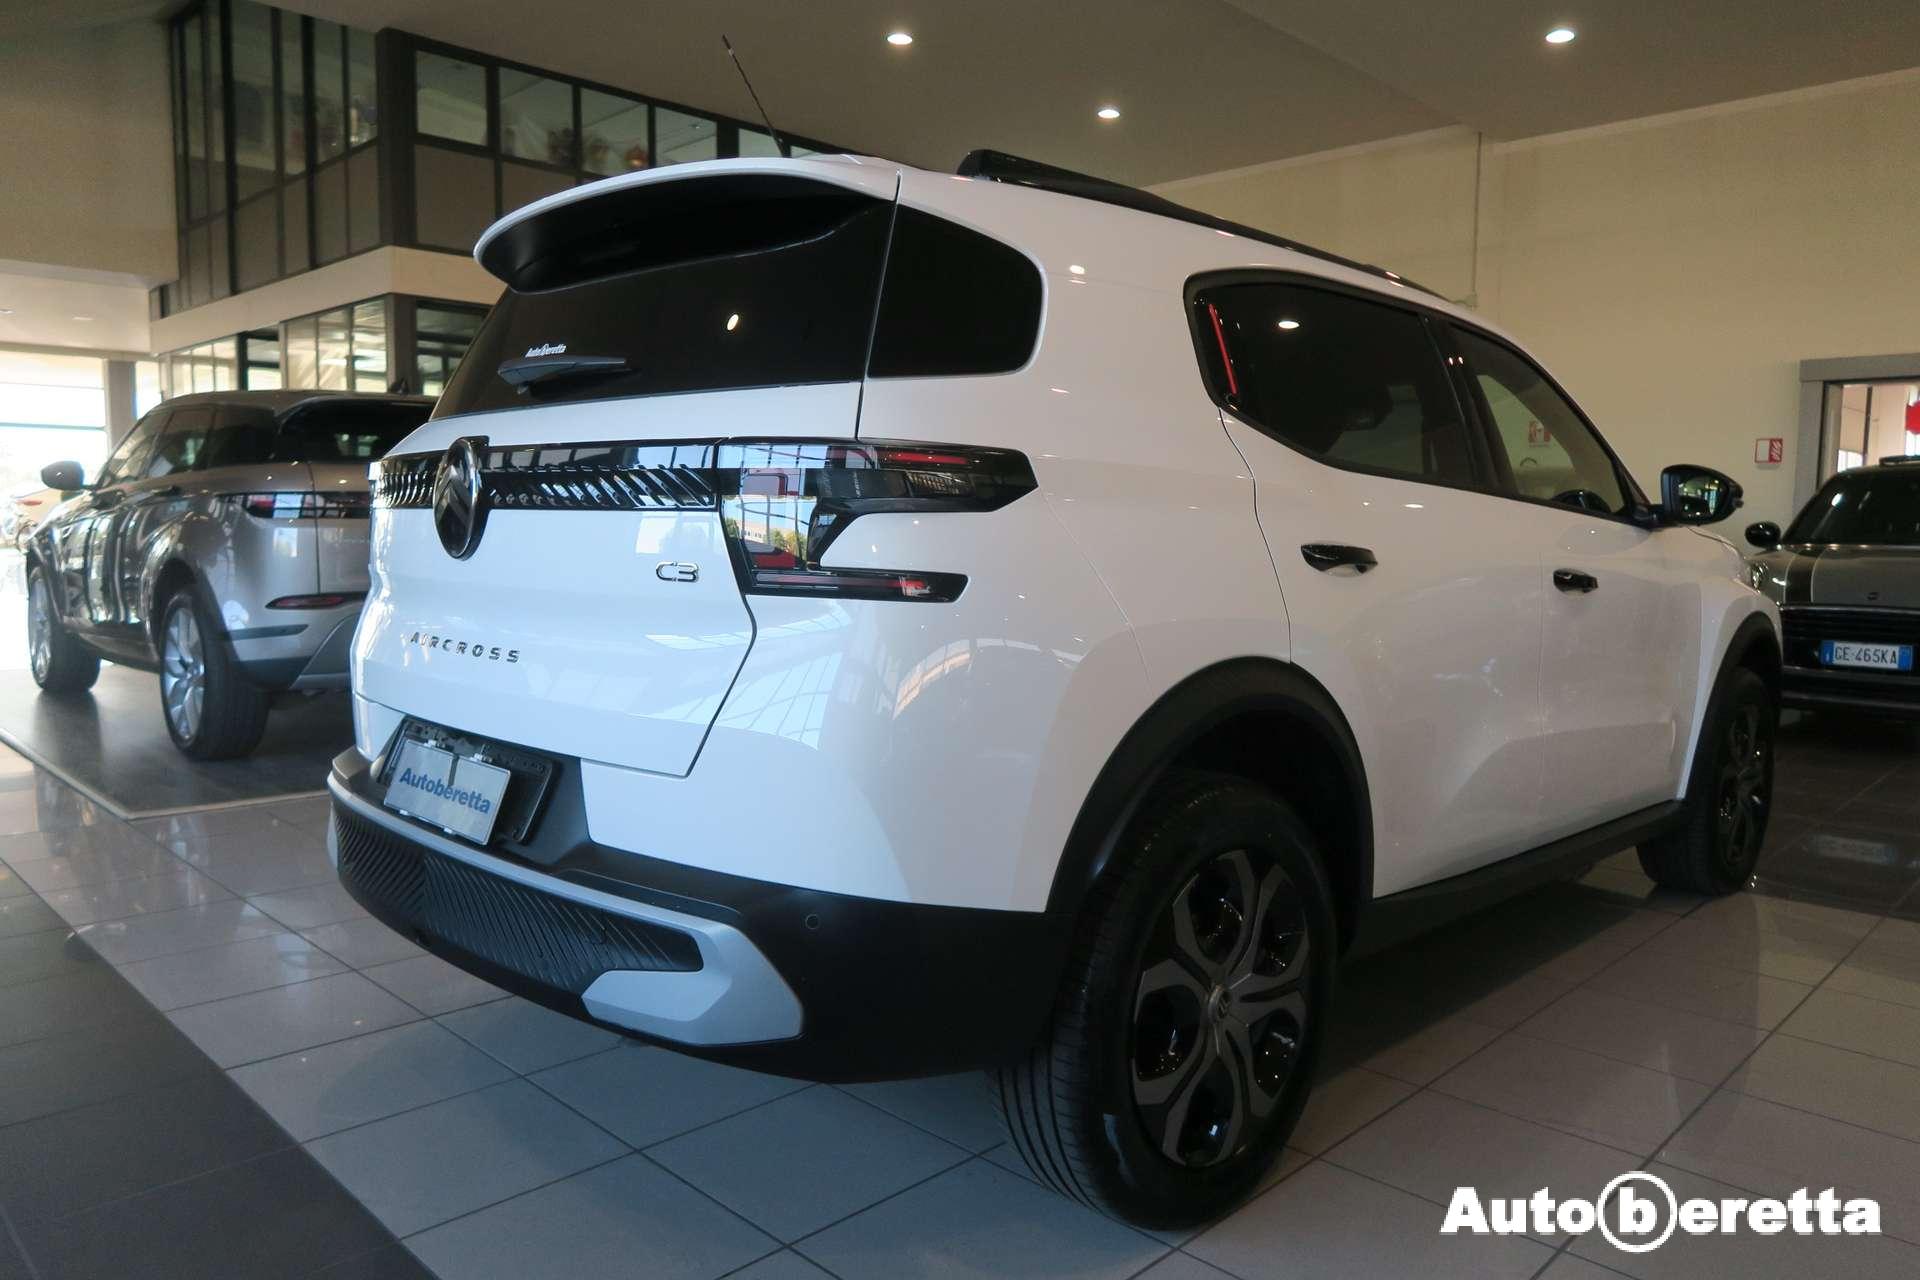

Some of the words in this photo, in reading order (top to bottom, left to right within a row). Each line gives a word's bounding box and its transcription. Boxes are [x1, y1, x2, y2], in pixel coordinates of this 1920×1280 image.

[655, 560, 700, 583] C3
[410, 631, 520, 663] AIRCROSS
[400, 767, 492, 815] Autoberetta
